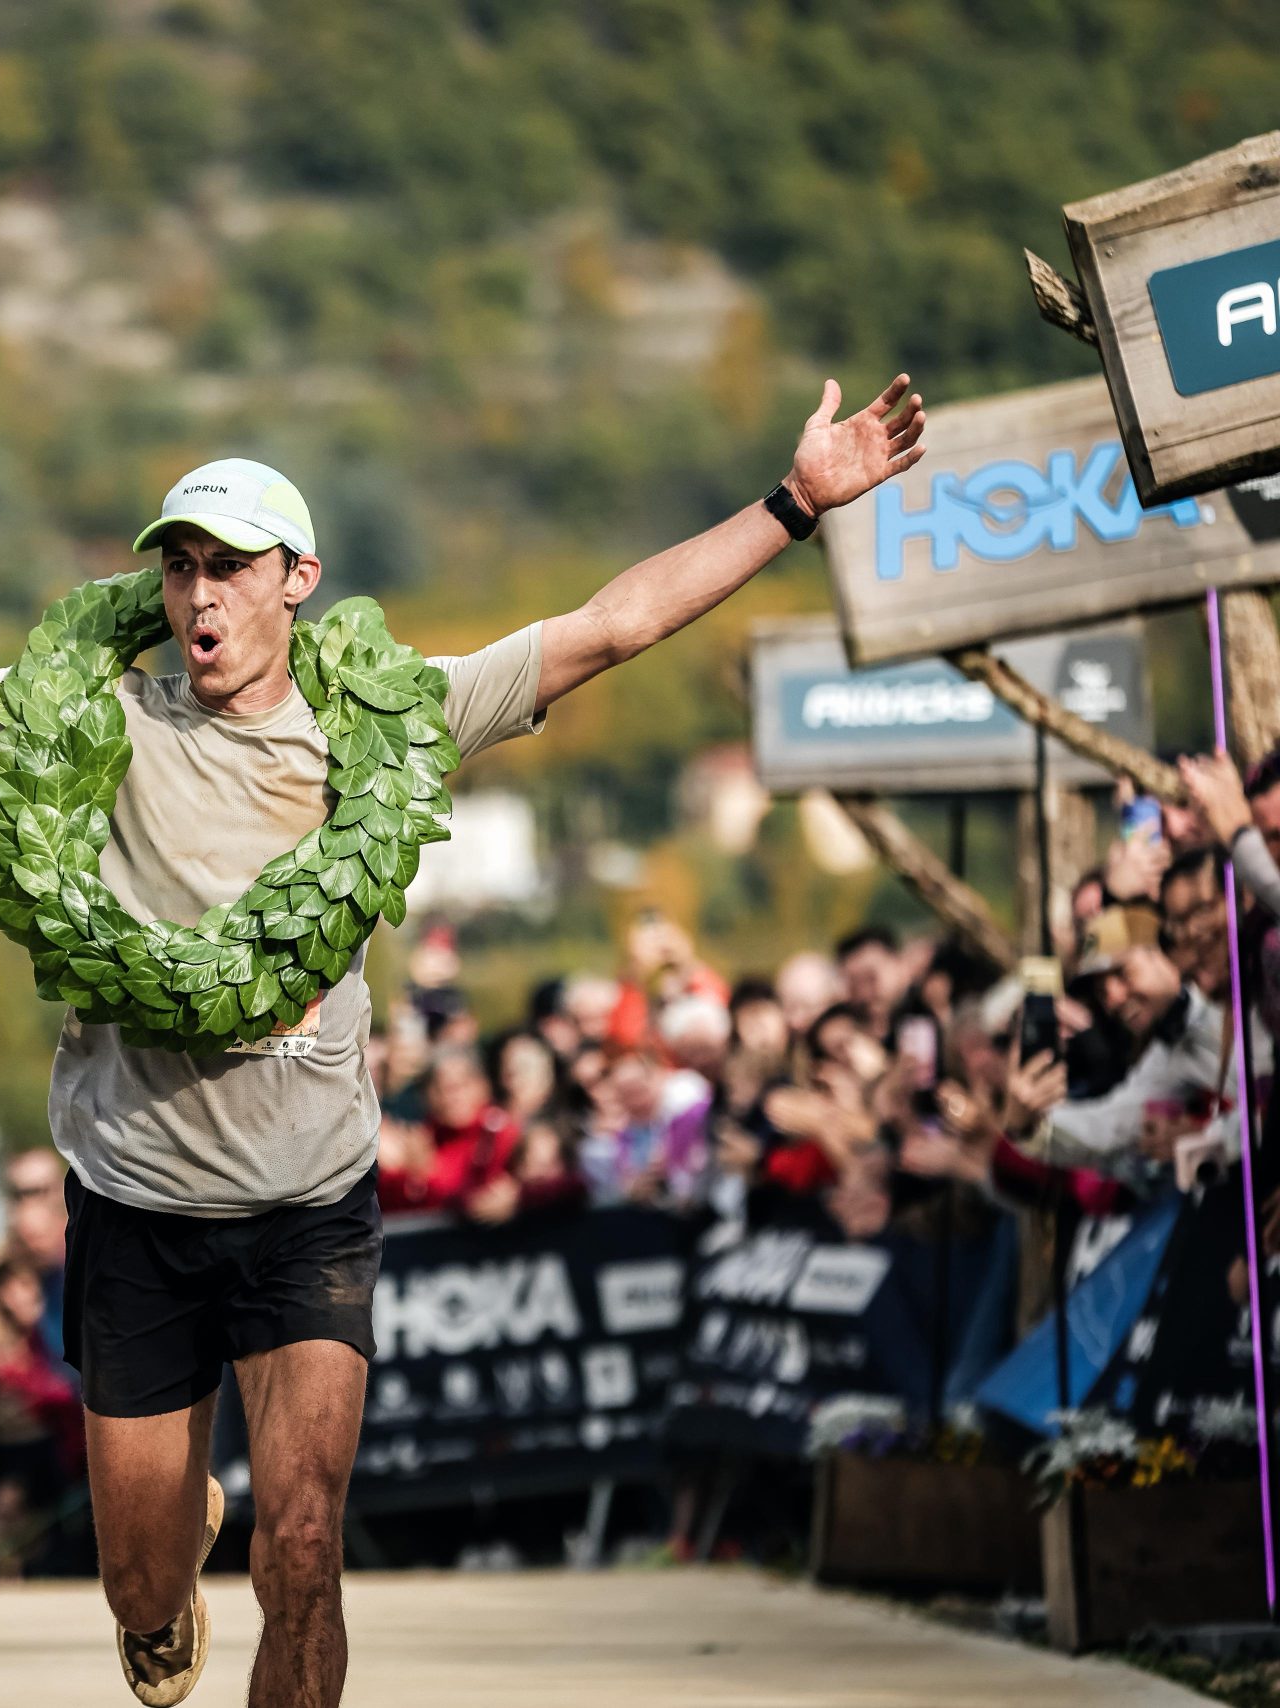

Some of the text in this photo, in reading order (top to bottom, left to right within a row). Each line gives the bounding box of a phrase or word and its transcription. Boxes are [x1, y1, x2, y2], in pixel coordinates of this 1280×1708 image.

[1216, 276, 1280, 347] A
[183, 485, 228, 496] KIPRUN
[370, 1251, 585, 1364] HOKA
